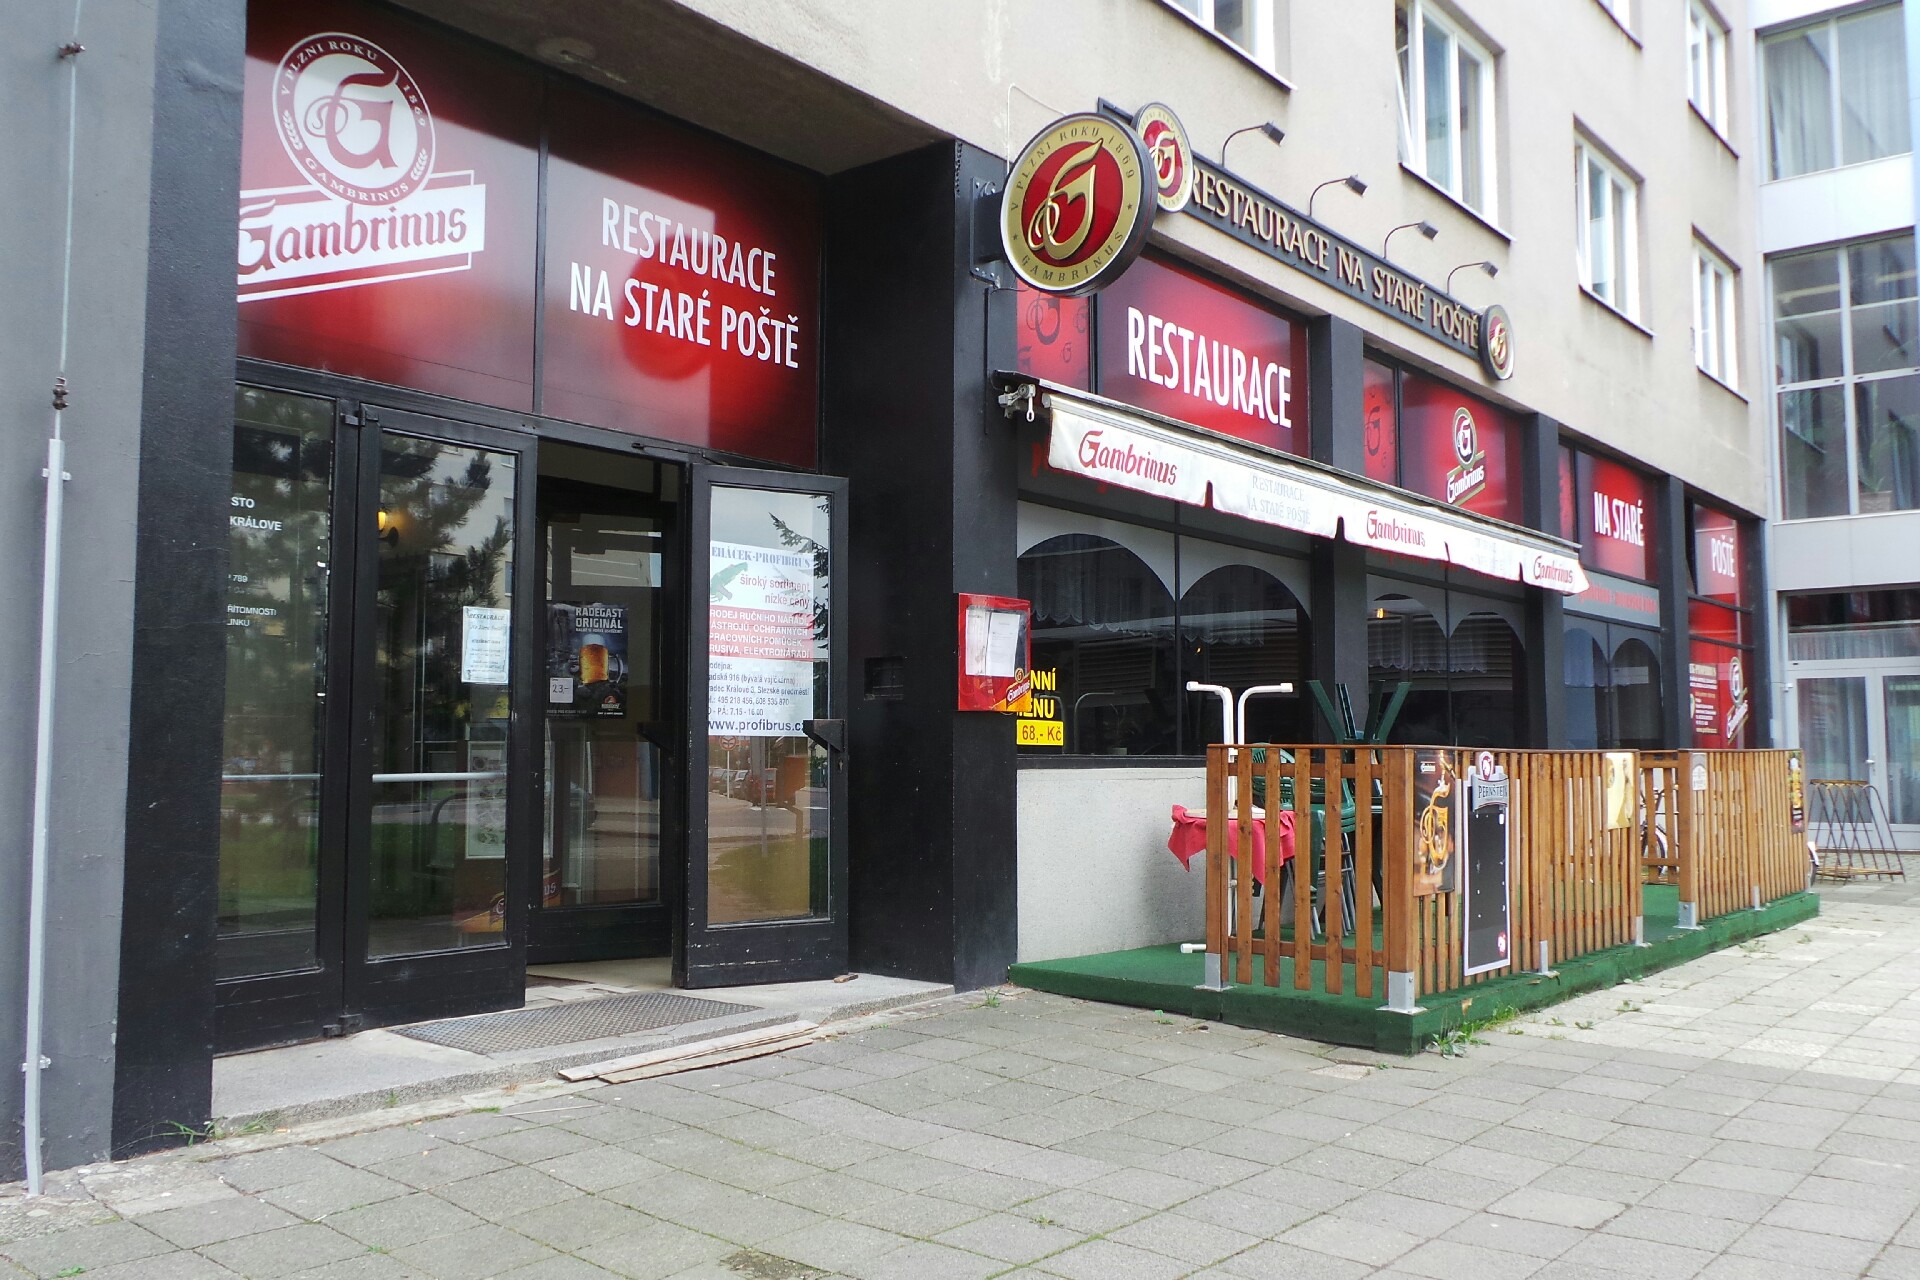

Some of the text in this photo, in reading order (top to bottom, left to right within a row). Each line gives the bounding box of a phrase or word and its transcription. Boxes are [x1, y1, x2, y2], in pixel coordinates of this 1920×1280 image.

[285, 44, 324, 80] PLZNI
[329, 40, 378, 61] ROKU
[403, 85, 425, 127] 1869
[306, 158, 408, 202] GAMBRINUS
[1017, 142, 1051, 190] PLZNI
[1060, 126, 1100, 142] ROKU
[1109, 135, 1135, 178] 1869
[238, 199, 467, 275] Gambrinus
[602, 197, 776, 297] RESTAURACE
[1021, 232, 1124, 282] GAMBRINUS
[1192, 166, 1330, 272] RESTAURACE
[1337, 246, 1367, 291] NA
[1373, 266, 1426, 322] STARÉ
[569, 261, 799, 369] NA STARÉ POŠTĚ
[1127, 306, 1292, 428] RESTAURACE
[1078, 430, 1178, 486] Gambrinus
[1447, 465, 1485, 504] Gambrinus
[1366, 510, 1426, 547] Gambrinus
[1593, 491, 1645, 547] NA STARÉ
[1533, 555, 1573, 584] Gambrinus
[1711, 534, 1736, 578] POŠTĚ
[740, 573, 767, 590] široký
[575, 607, 624, 618] RADEGAST
[575, 617, 624, 629] ORIGINÁL
[708, 719, 804, 733] www.profibrus.c
[1022, 725, 1062, 744] 68,- Kč
